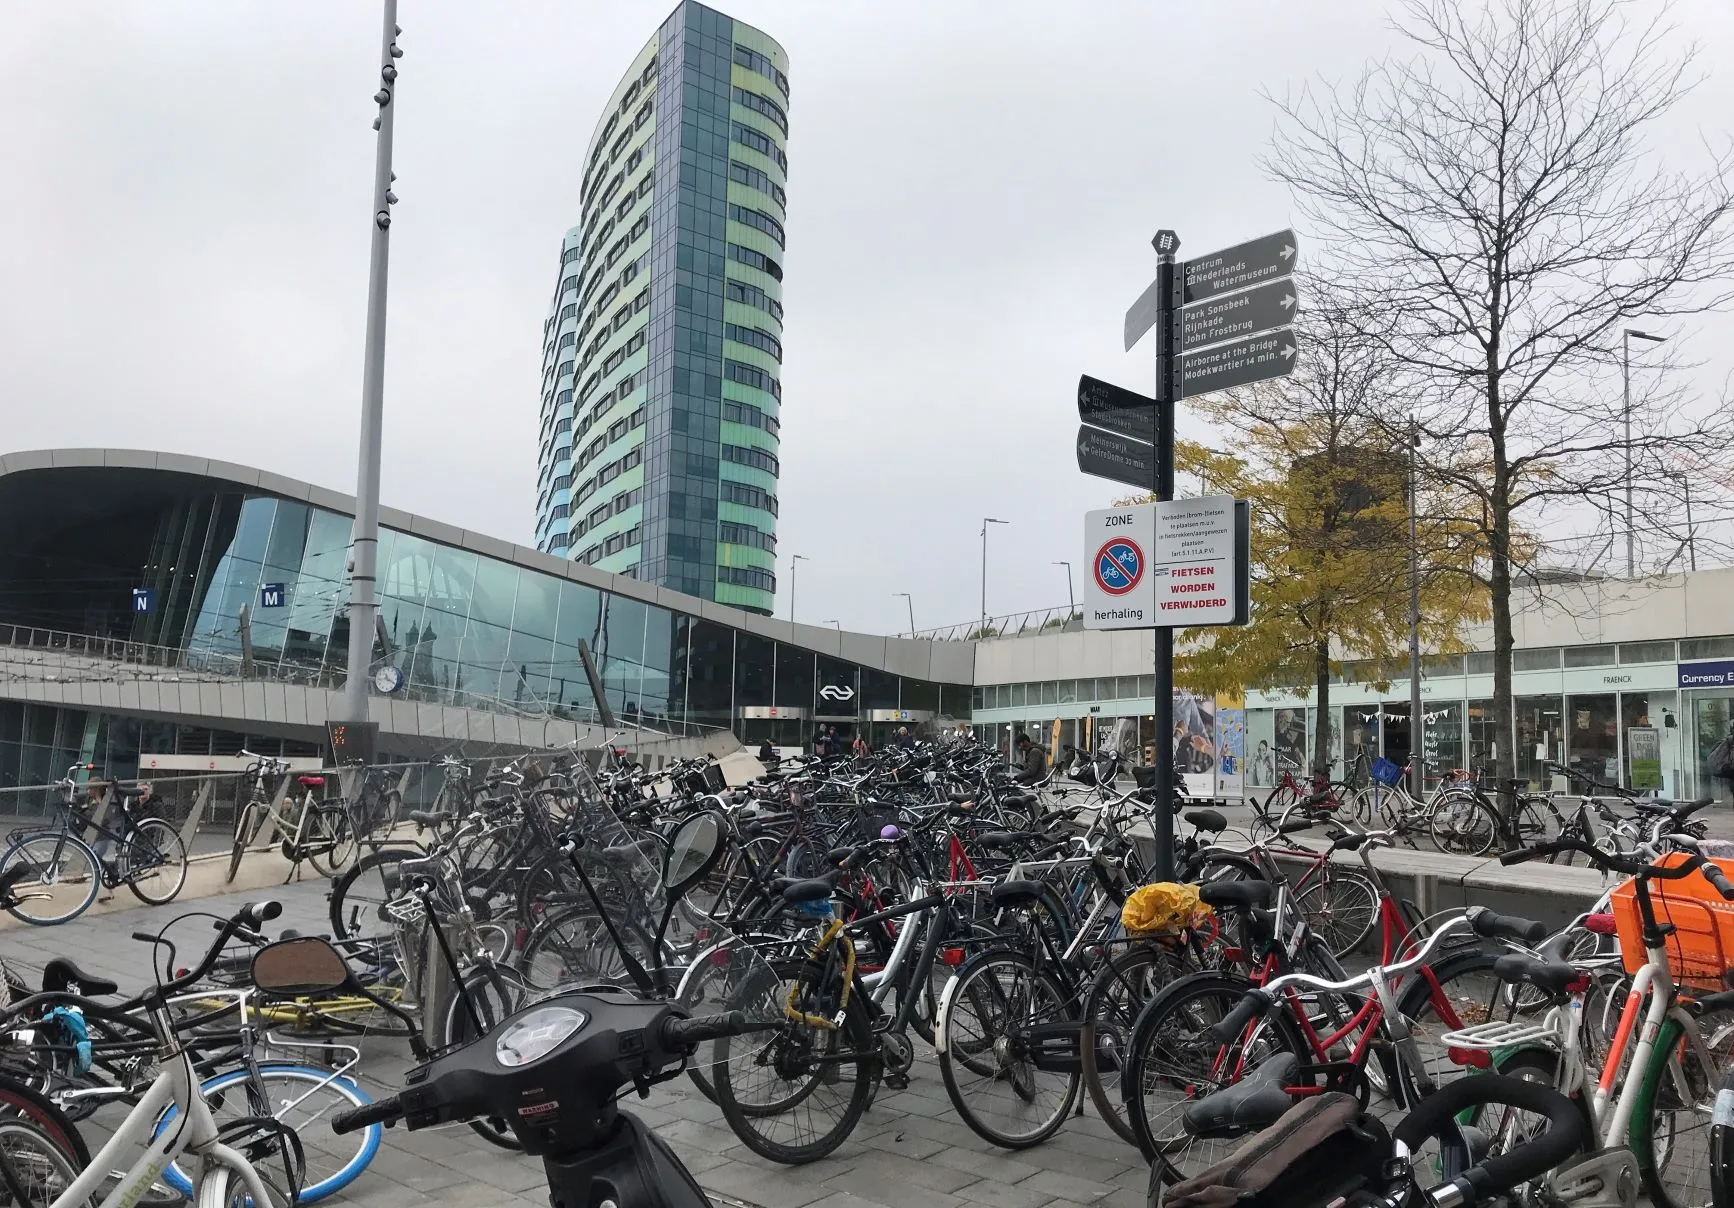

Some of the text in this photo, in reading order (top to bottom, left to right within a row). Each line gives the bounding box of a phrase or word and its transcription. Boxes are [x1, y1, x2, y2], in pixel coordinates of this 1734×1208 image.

[1185, 258, 1223, 275] Centrum
[1196, 262, 1246, 284] Nederlands
[1213, 265, 1277, 289] Watermuseum
[1185, 296, 1250, 321] Park Sonsbeek
[1185, 316, 1223, 333] Rijnkade
[1185, 320, 1253, 344] John Frostbrug
[1185, 339, 1278, 368] Airborne at the Bridge
[1185, 351, 1278, 380] Modekwartier 14 min.
[1105, 514, 1133, 527] ZONE
[1176, 522, 1198, 530] plaatsen
[1172, 566, 1214, 578] FIETSEN
[1171, 583, 1215, 593] WORDEN
[137, 597, 147, 610] N
[264, 592, 278, 606] M
[1160, 598, 1226, 610] VERWIJDERD
[1094, 608, 1142, 620] herhaling
[1603, 675, 1632, 684] FRAENCK
[1682, 674, 1724, 684] Currency
